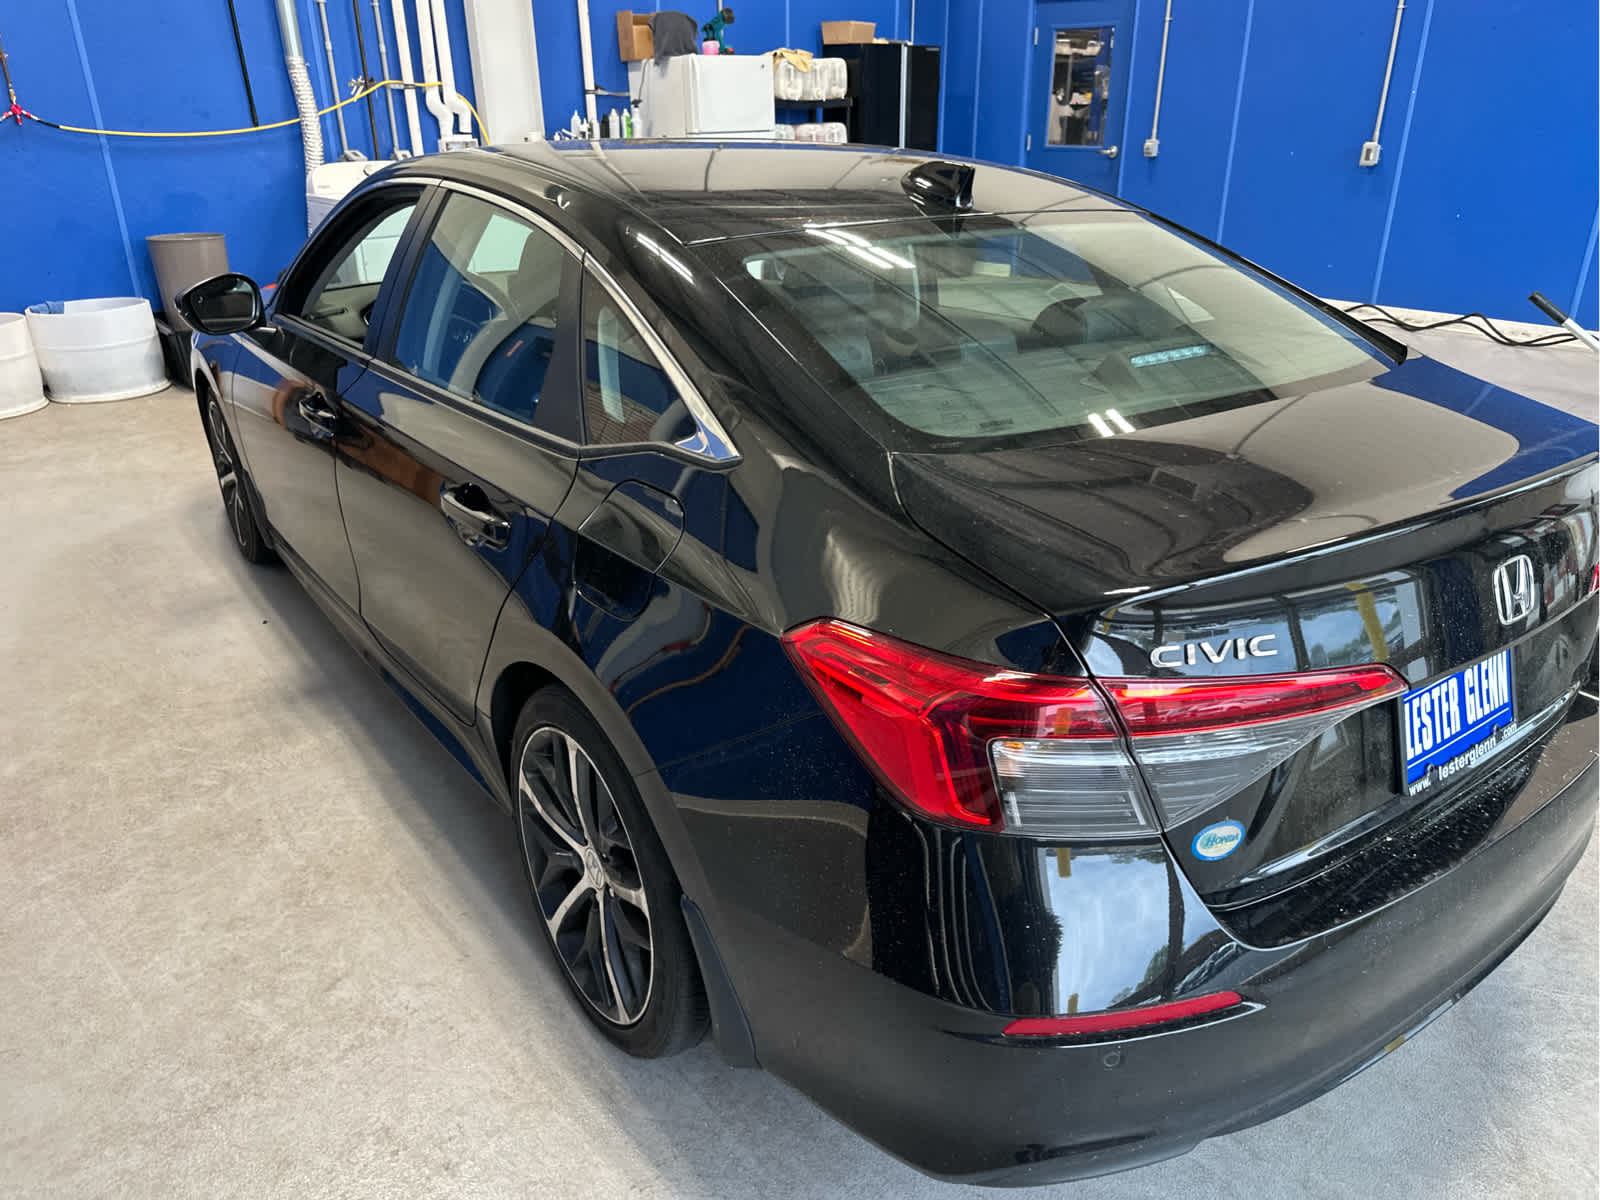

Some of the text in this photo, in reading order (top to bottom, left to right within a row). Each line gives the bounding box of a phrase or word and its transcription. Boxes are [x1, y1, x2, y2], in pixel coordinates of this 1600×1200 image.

[1150, 633, 1278, 668] CIVIC
[1404, 650, 1509, 761] LESTER GLENN
